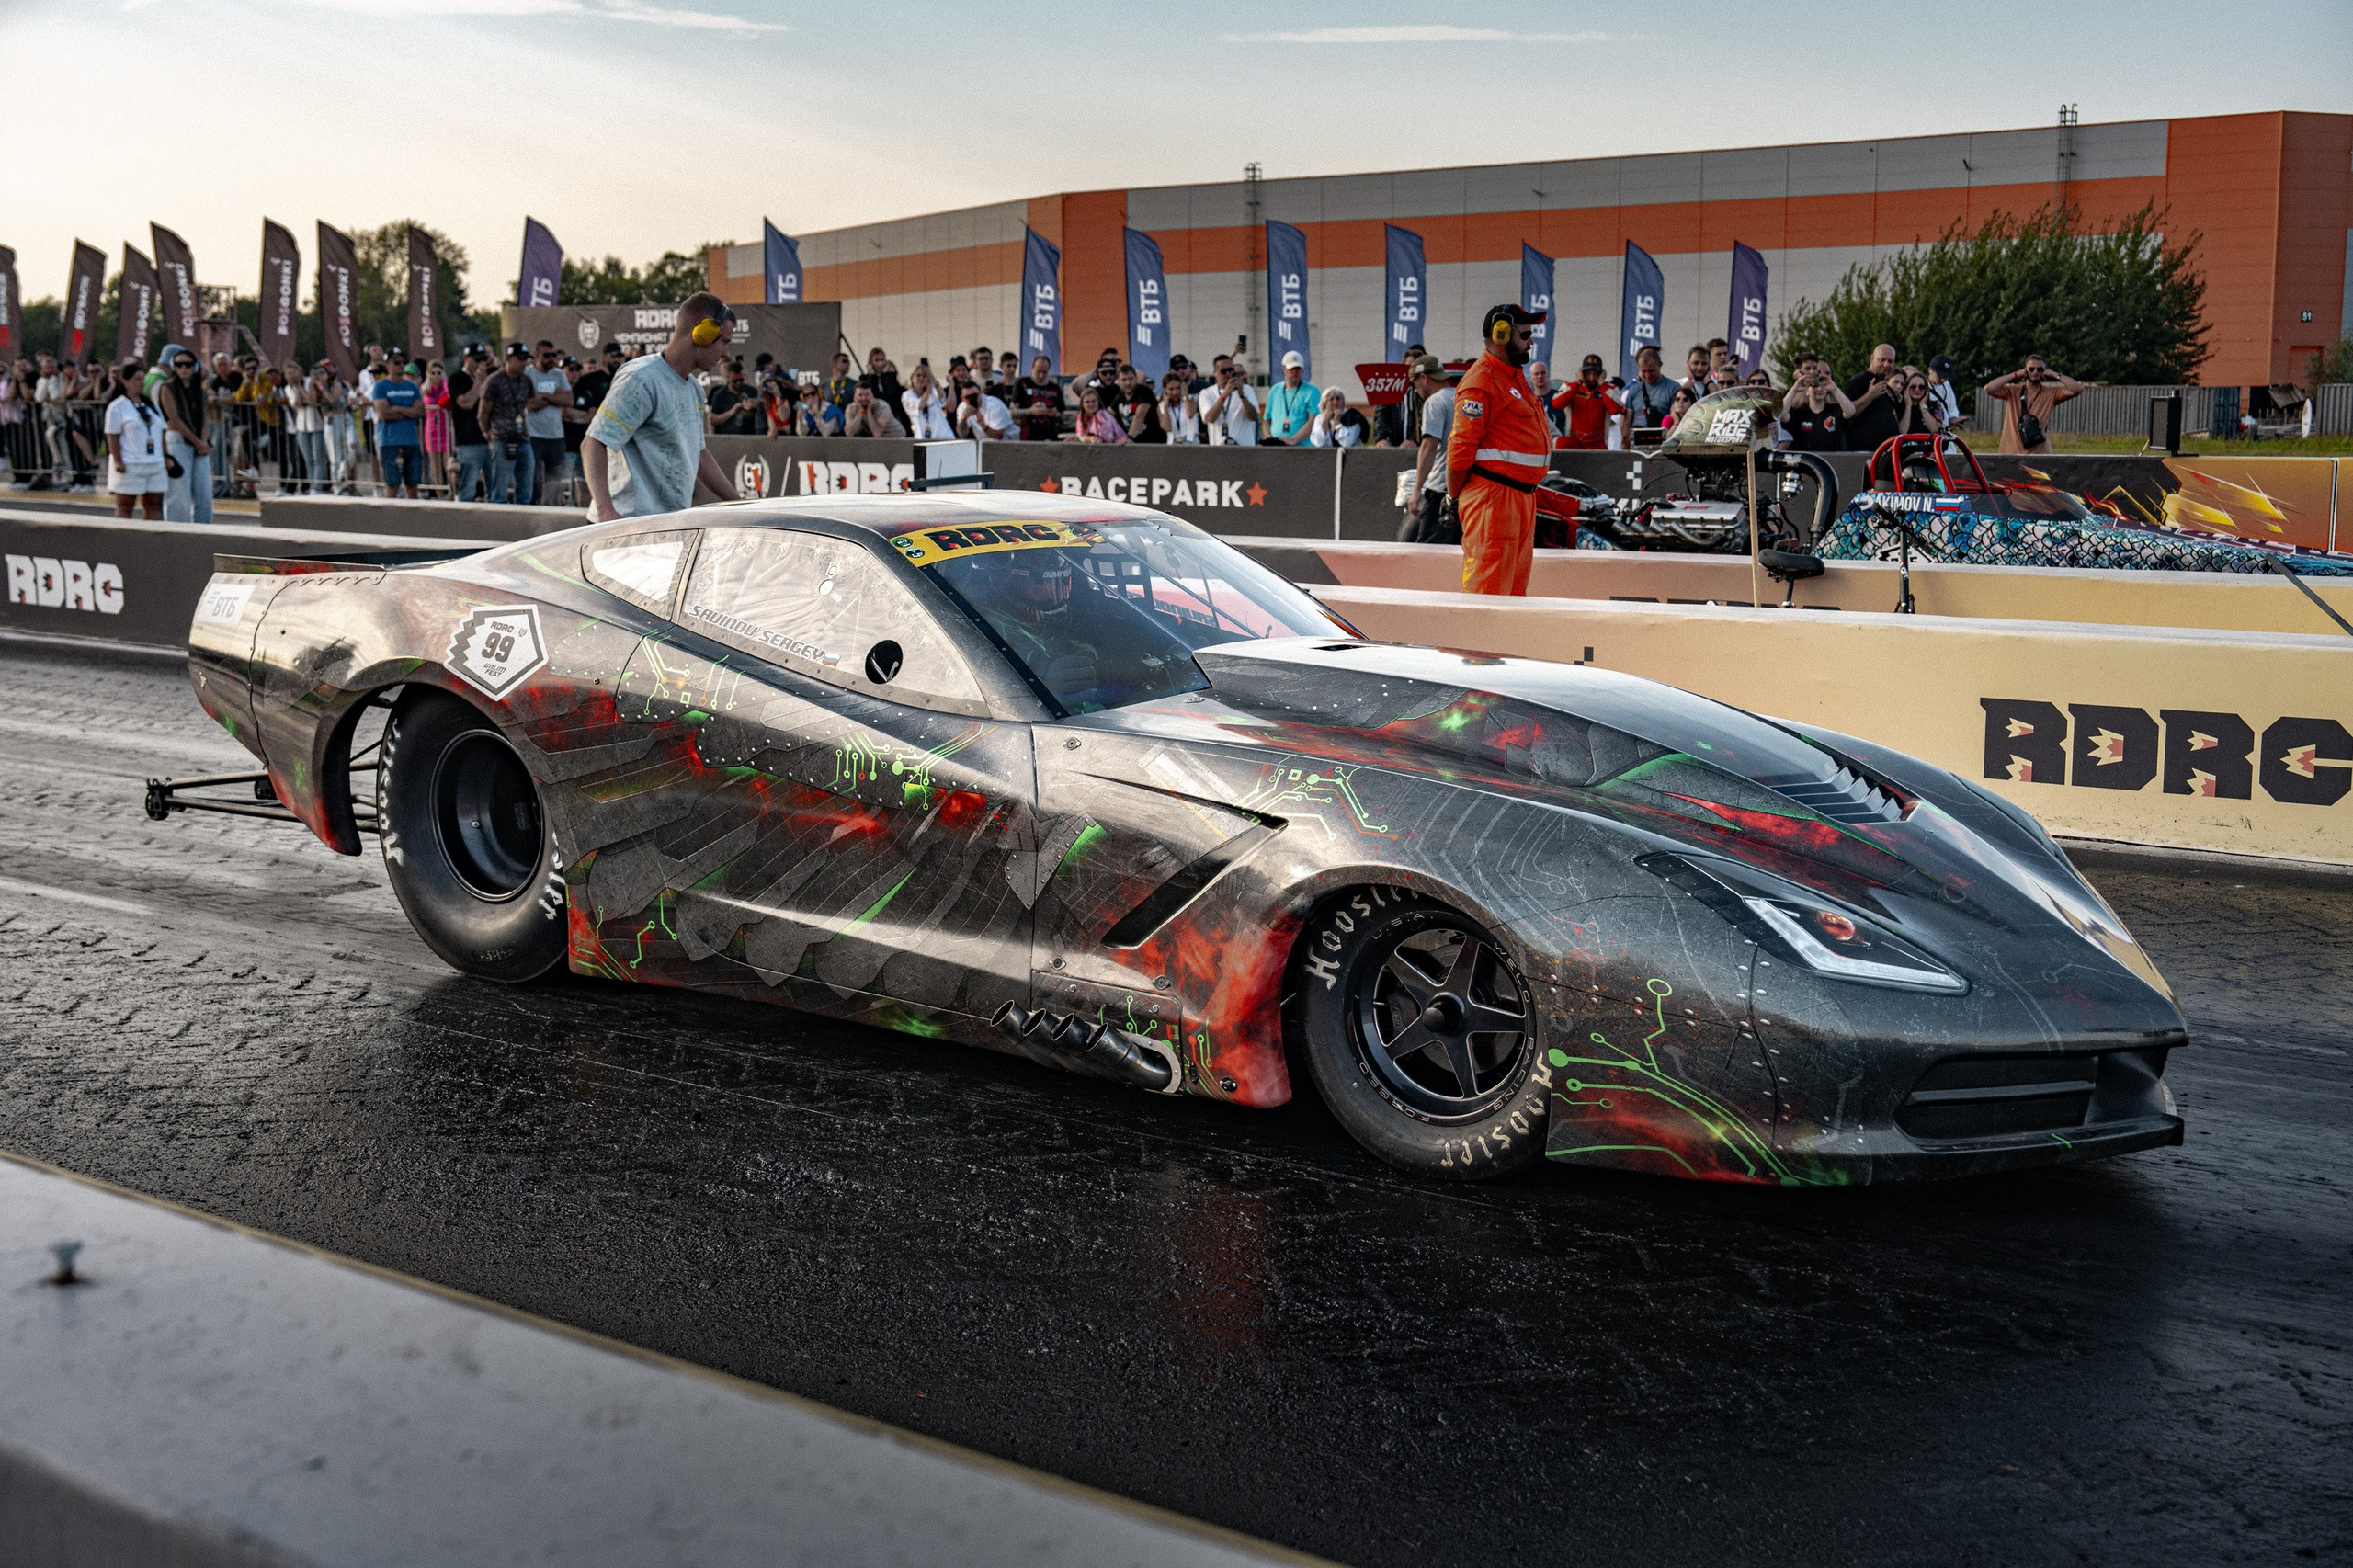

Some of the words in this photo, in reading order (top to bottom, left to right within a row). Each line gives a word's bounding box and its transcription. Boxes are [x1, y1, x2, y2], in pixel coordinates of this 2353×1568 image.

[530, 277, 553, 307] ТБ
[778, 272, 798, 302] ТБ
[1140, 279, 1161, 324] ВТБ
[1281, 273, 1302, 319] ВТБ
[1399, 276, 1418, 321] ВТБ
[1035, 283, 1056, 330] ВТБ
[1530, 293, 1549, 339] ВБ
[1635, 294, 1654, 339] ВТБ
[1741, 297, 1762, 342] ВТБ
[2302, 312, 2312, 322] 51
[797, 370, 821, 386] ВТБ
[1365, 377, 1407, 392] 357M
[1467, 402, 1479, 410] FIA
[1712, 408, 1756, 424] MAX
[798, 460, 915, 495] RDRC
[1061, 476, 1245, 507] RACEPARK
[1875, 496, 1922, 512] AKIMOV
[1923, 497, 1935, 512] N.
[924, 524, 1060, 551] RDRC
[5, 553, 125, 614] RDRC
[211, 596, 236, 618] ВТБ
[490, 620, 515, 633] RDRC
[481, 631, 516, 663] 99
[758, 630, 826, 662] SERGEY
[484, 669, 502, 677] FEST
[1979, 697, 2353, 807] RDRC
[1495, 942, 1531, 1003] WELD
[1493, 1036, 1535, 1111] RACING
[1359, 1062, 1430, 1123] FORGED
